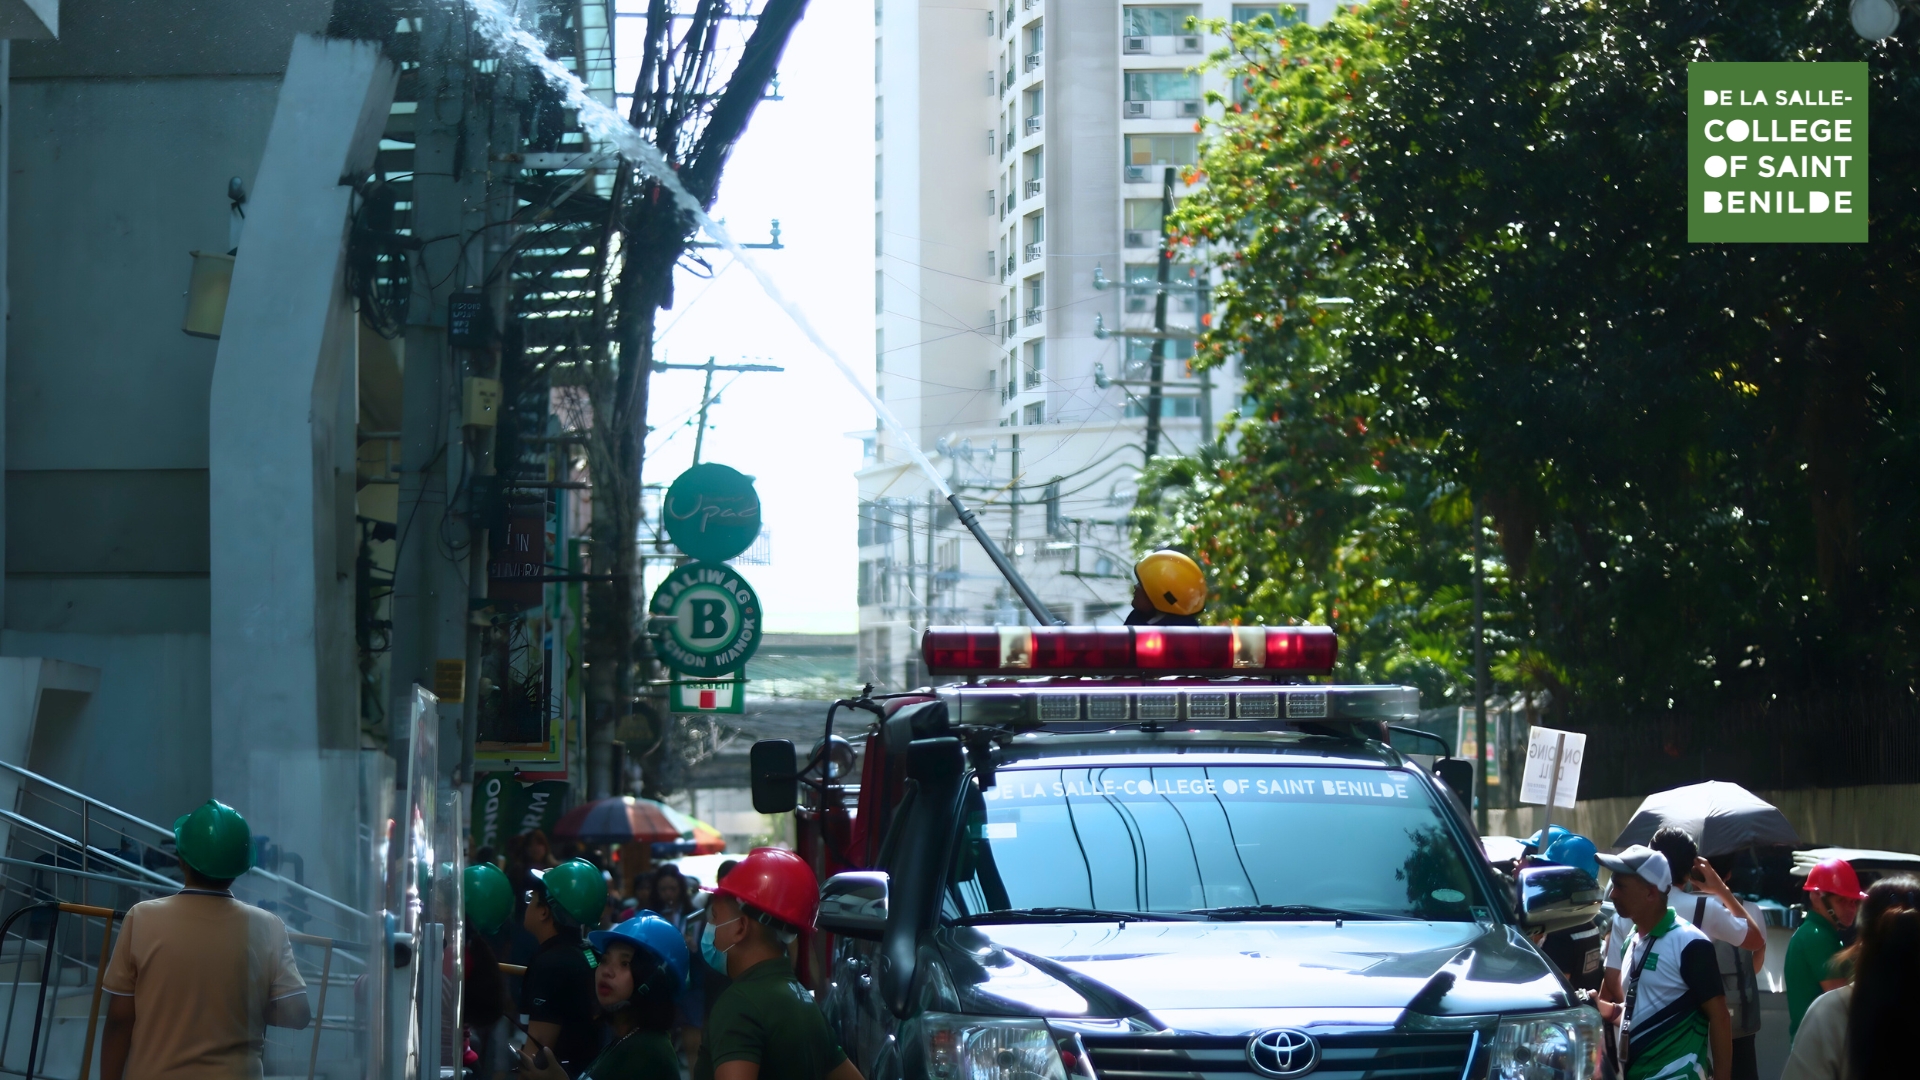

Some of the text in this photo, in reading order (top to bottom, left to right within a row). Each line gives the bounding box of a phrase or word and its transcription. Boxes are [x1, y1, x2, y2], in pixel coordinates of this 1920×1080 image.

[657, 569, 751, 609] BALIWAG
[689, 598, 729, 640] B
[715, 617, 756, 667] MANOK
[1021, 783, 1047, 798] LA
[1053, 779, 1215, 797] SALLE-COLLEGE
[1222, 779, 1249, 795] OF
[1256, 779, 1315, 795] SAINT
[1322, 780, 1409, 799] BENILDE
